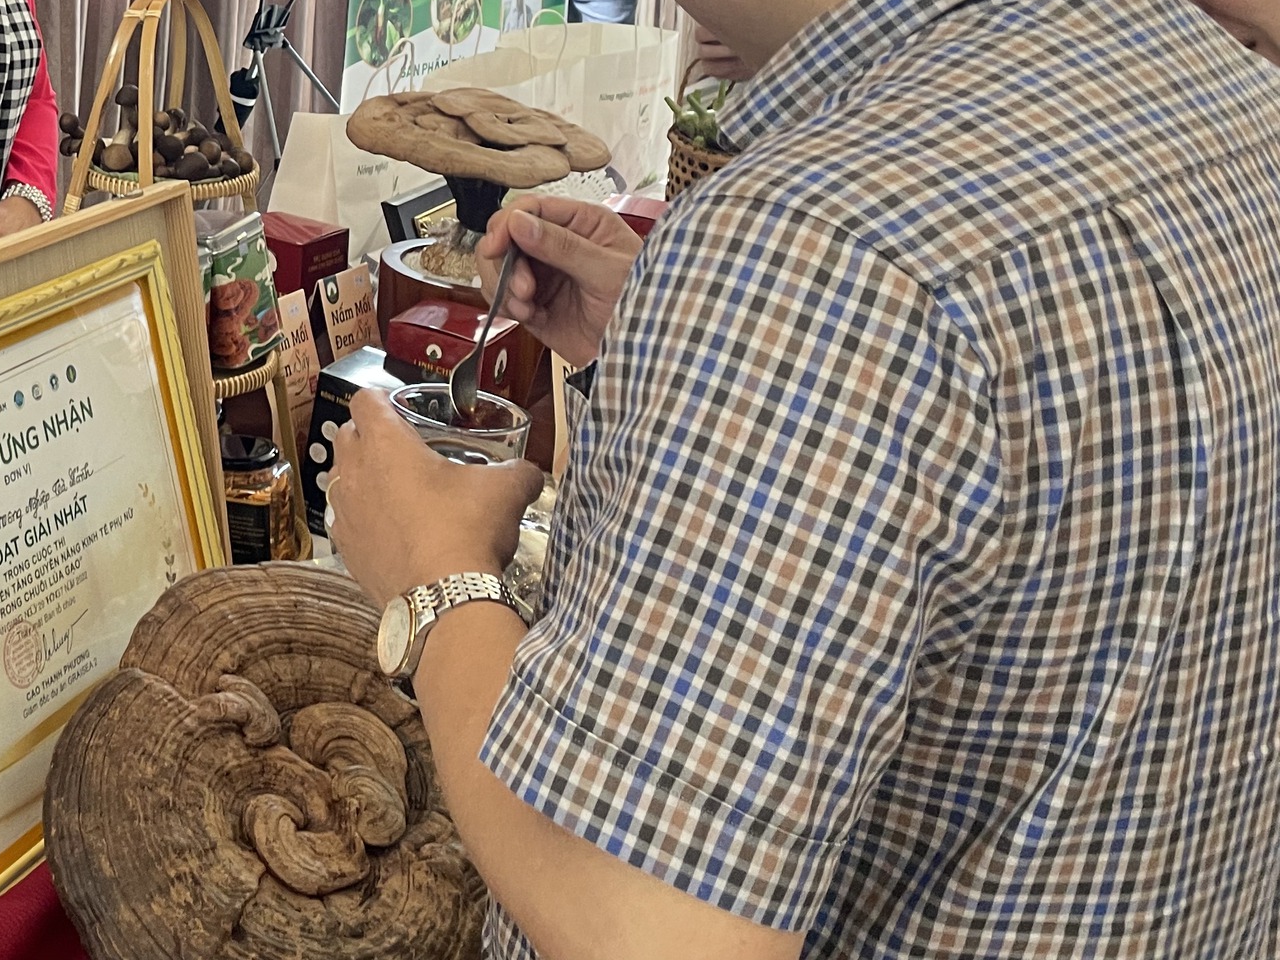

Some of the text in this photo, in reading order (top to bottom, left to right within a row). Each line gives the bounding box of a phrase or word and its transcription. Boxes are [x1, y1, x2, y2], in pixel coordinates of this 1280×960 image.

[331, 293, 371, 326] Nấm Mối
[291, 322, 308, 347] Mối
[335, 333, 354, 350] Đen
[42, 396, 94, 442] NHẬN
[4, 462, 32, 486] ĐƠN VỊ
[24, 516, 52, 548] GIẢI
[54, 492, 88, 531] NHẤT
[81, 530, 99, 551] KINH
[3, 536, 67, 583] TRONG CUỘC THI
[26, 685, 41, 702] CAO
[41, 668, 63, 690] THANH
